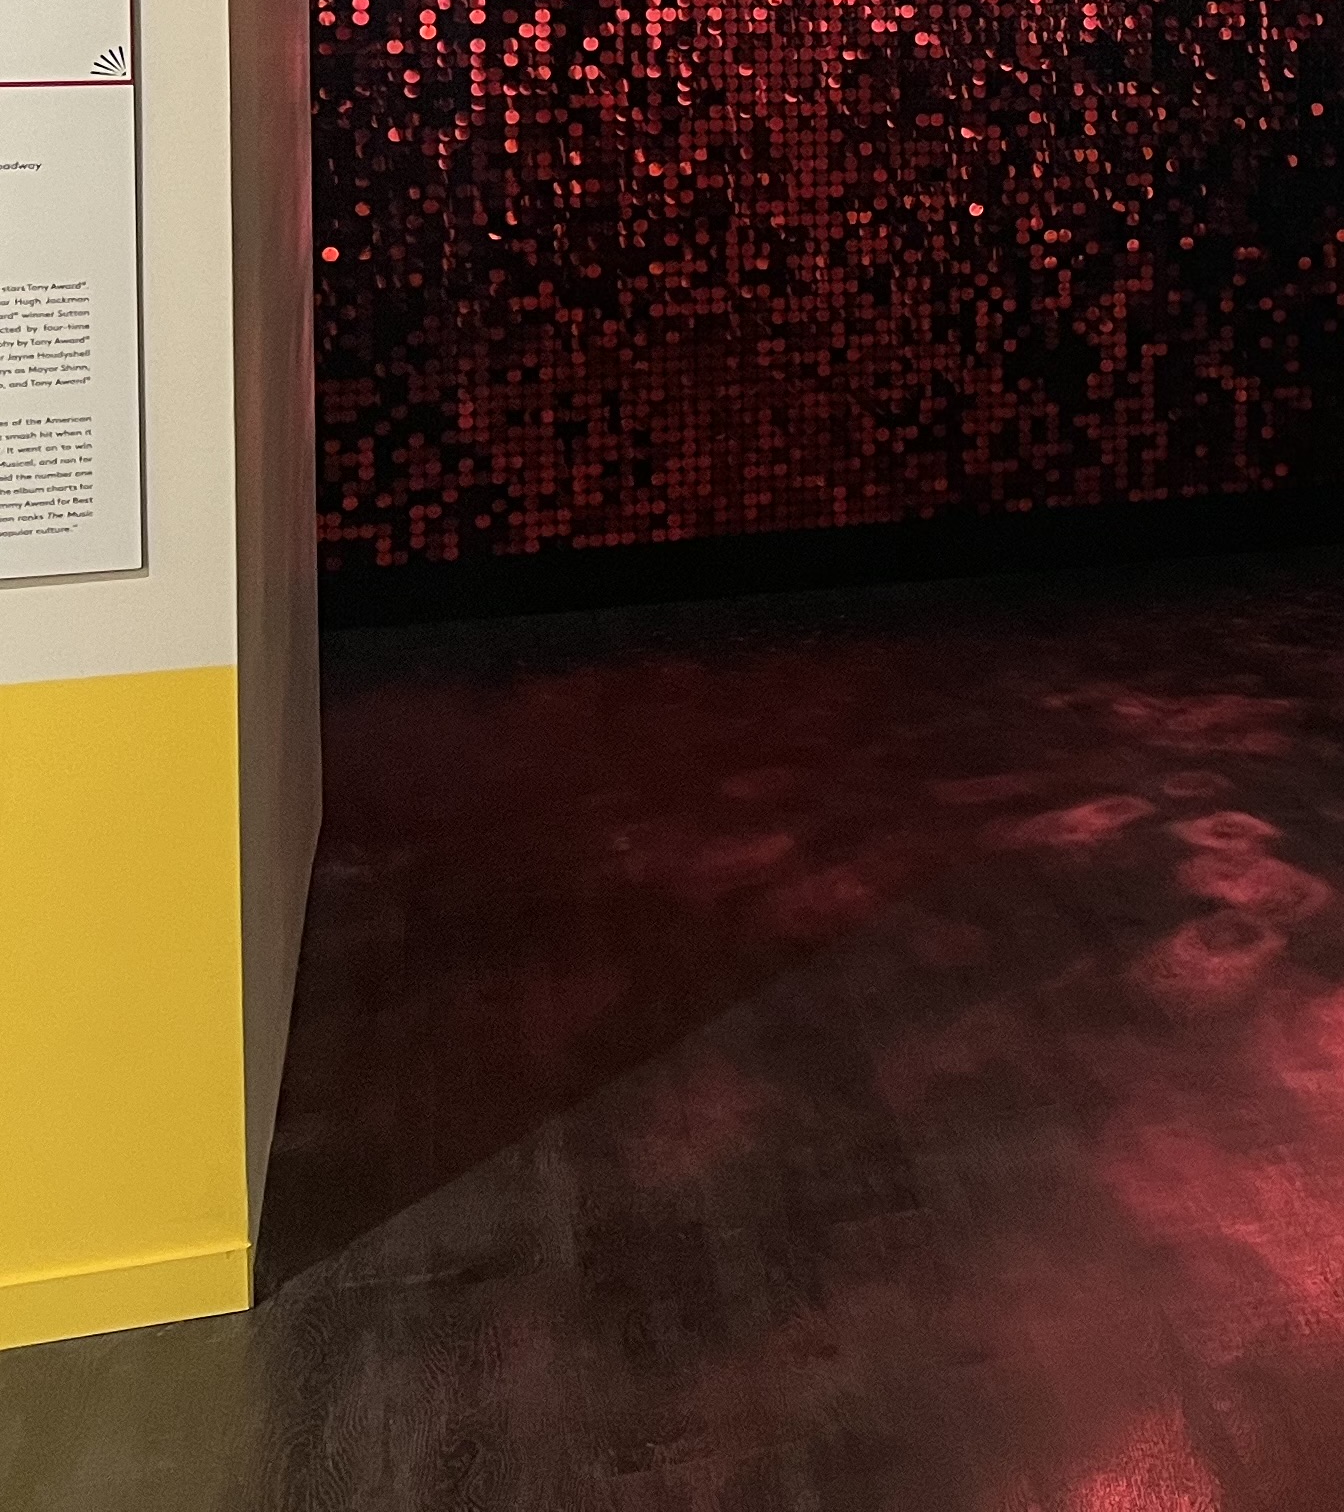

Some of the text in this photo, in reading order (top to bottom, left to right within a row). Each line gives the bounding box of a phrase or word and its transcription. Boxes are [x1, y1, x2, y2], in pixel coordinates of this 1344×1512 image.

[27, 283, 49, 292] Tony
[15, 298, 41, 307] Hugh
[58, 309, 90, 317] Sutton
[27, 325, 38, 333] by
[30, 338, 52, 347] Tony
[8, 353, 35, 361] Jayne
[29, 366, 58, 374] Mayor
[9, 380, 28, 388] and
[31, 378, 52, 388] Tony
[46, 416, 92, 424] American
[5, 432, 36, 440] smash
[56, 429, 82, 437] when
[39, 458, 58, 466] and
[16, 473, 32, 481] the
[35, 471, 72, 480] number
[13, 482, 93, 495] album charts for
[24, 499, 55, 507] Award
[58, 497, 70, 505] for
[18, 510, 93, 522] ranks The Music
